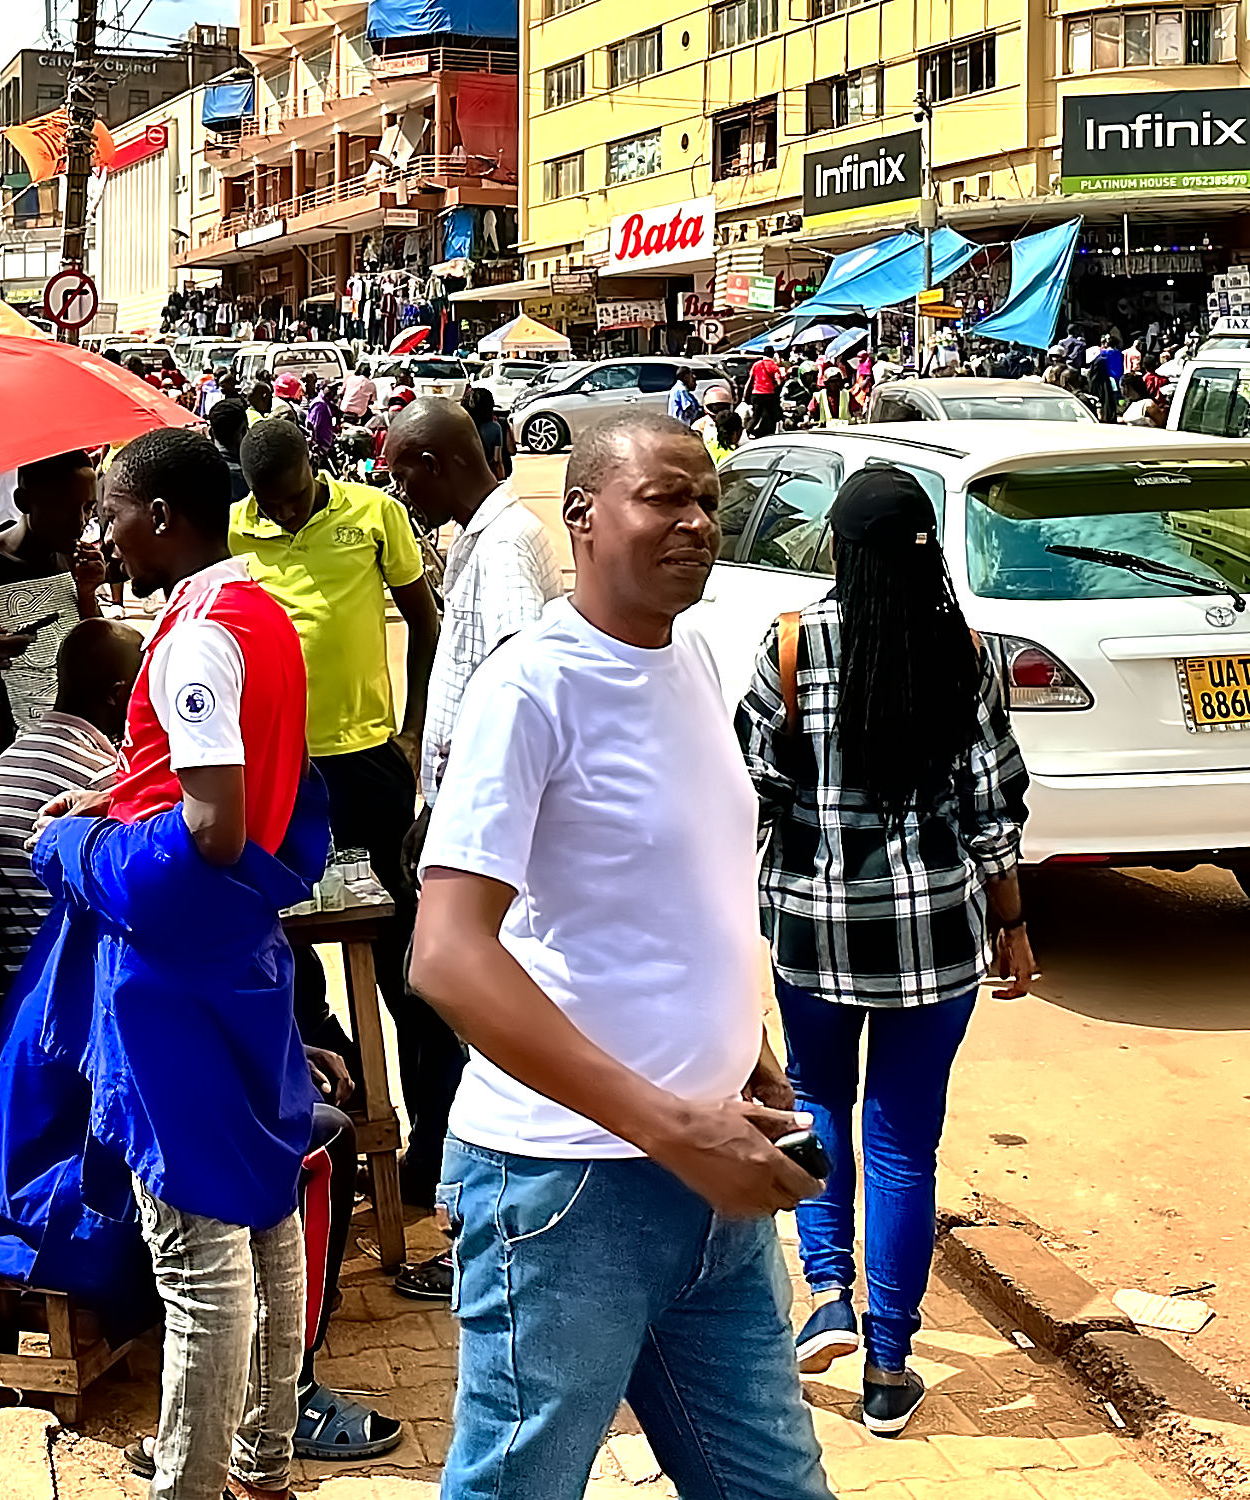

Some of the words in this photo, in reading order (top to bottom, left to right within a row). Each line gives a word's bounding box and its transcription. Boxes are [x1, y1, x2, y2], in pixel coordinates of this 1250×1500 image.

[1086, 110, 1247, 151] Infinix
[815, 147, 906, 198] Infinix
[1080, 179, 1138, 190] PLATINUM
[1139, 177, 1177, 188] HOUSE
[614, 207, 705, 261] Bata
[705, 322, 719, 340] P
[1208, 658, 1250, 688] UAT
